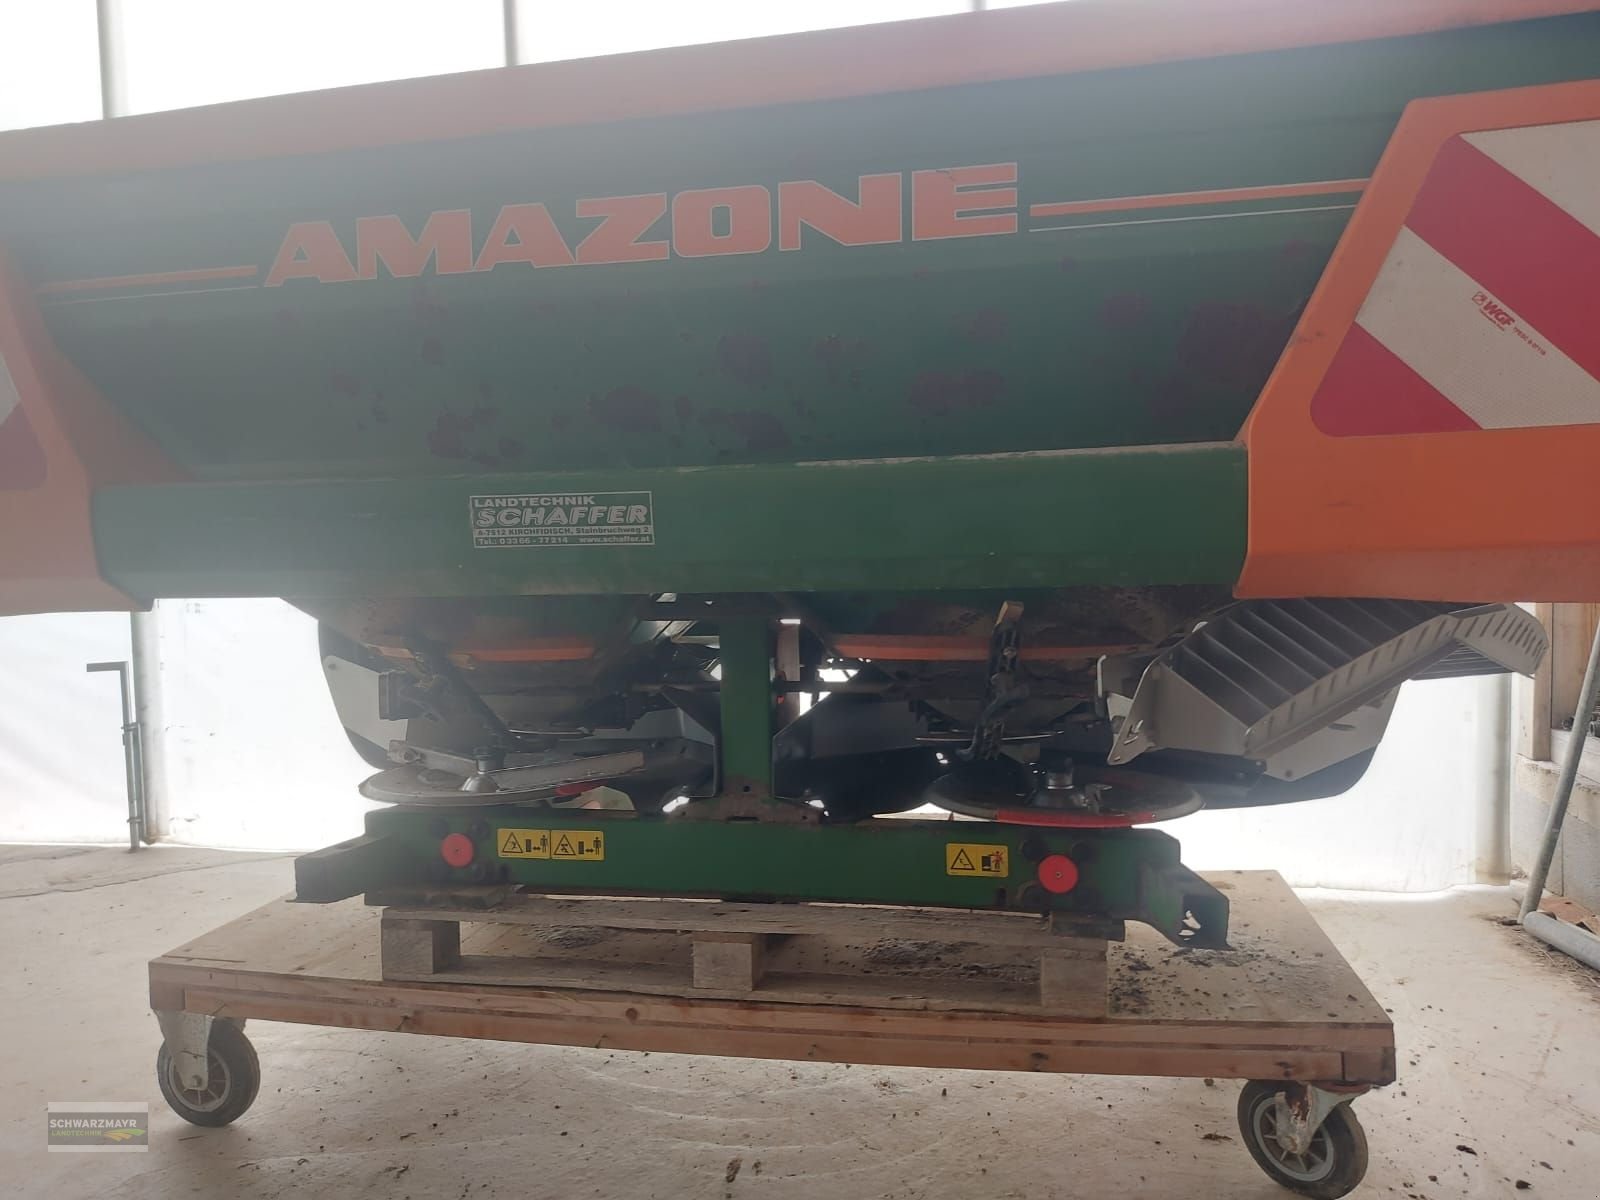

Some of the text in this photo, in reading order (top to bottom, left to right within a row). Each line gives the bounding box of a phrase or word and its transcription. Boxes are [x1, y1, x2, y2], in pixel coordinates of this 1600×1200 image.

[263, 162, 1018, 288] AMAZONE
[1483, 301, 1515, 326] WGF
[474, 496, 595, 507] LANDTECHNIK
[477, 505, 648, 527] SCHAFFER
